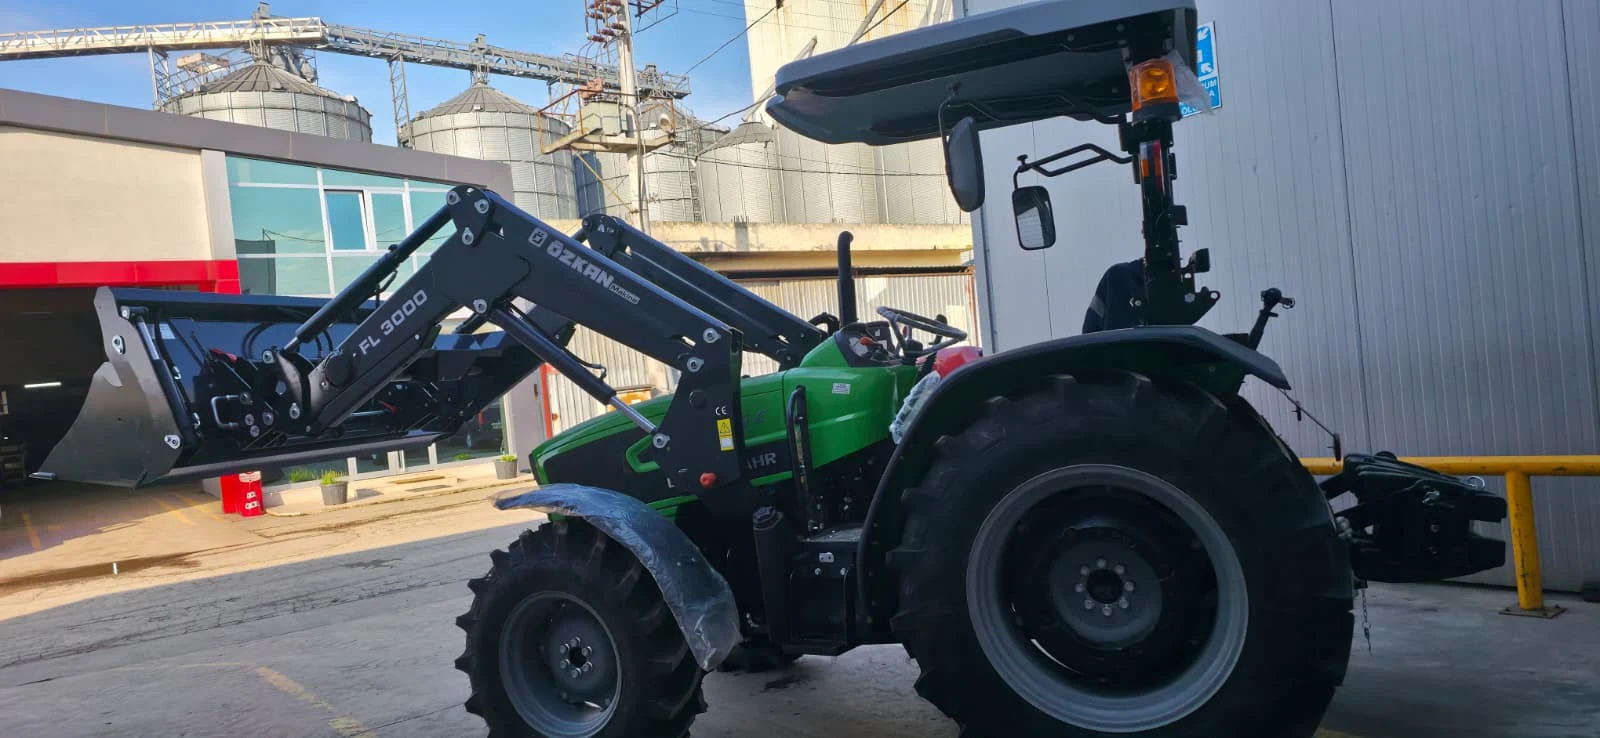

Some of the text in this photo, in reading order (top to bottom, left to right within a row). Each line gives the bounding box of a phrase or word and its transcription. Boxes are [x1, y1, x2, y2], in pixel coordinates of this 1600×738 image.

[546, 240, 614, 289] ÖZKAN
[359, 289, 427, 355] FL 3000
[715, 406, 728, 416] CE
